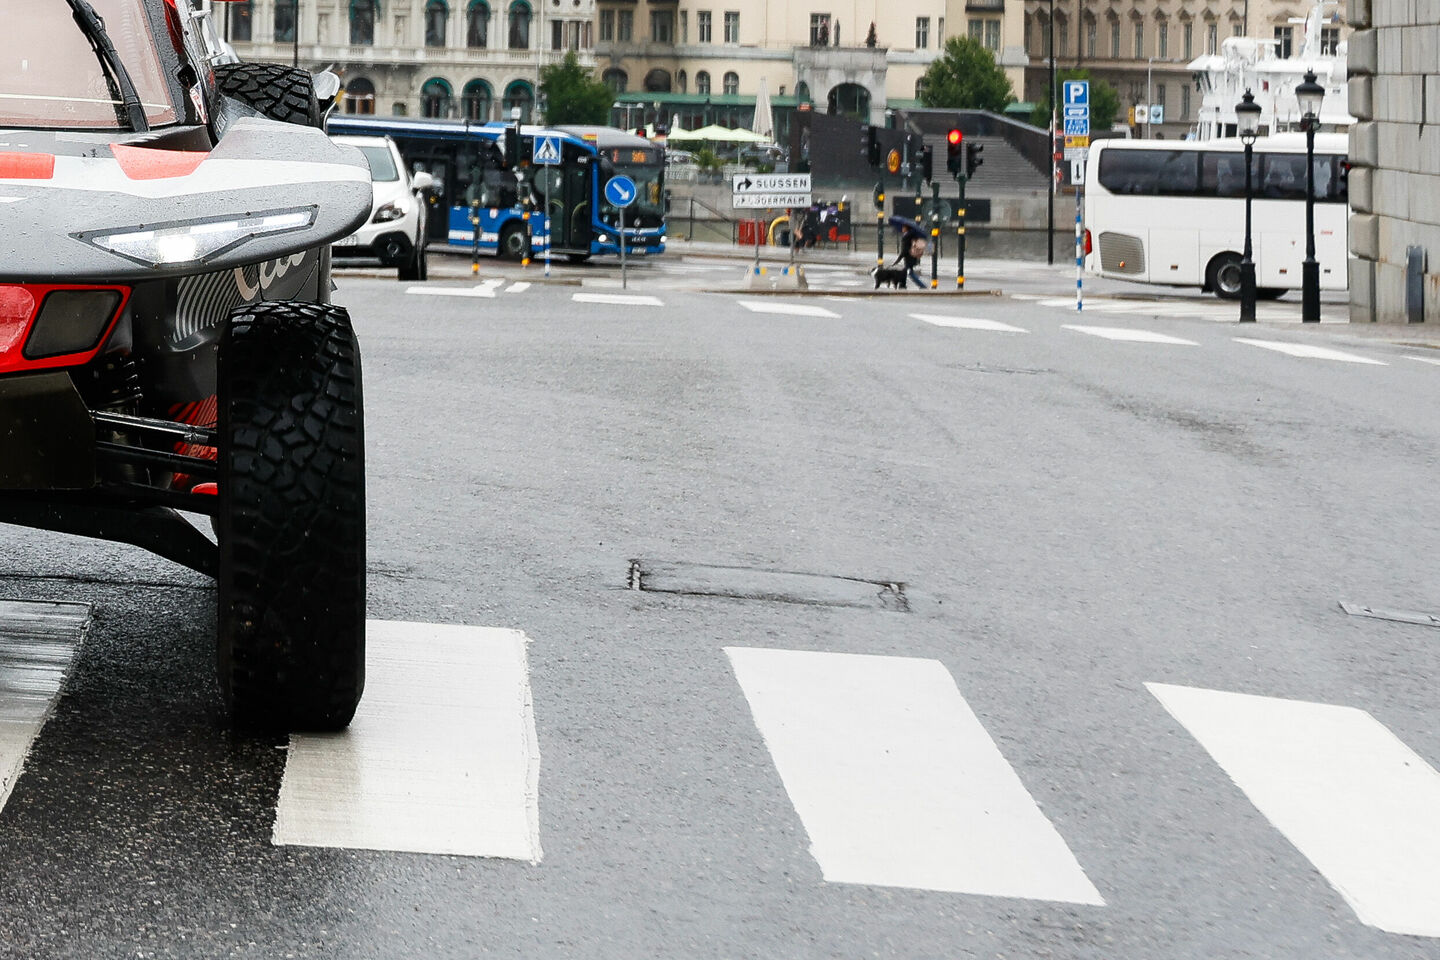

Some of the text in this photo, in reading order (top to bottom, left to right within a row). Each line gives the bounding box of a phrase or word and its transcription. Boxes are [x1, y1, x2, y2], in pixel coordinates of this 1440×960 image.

[1069, 84, 1084, 104] P
[755, 179, 807, 189] SLUSSEN
[748, 195, 805, 205] DERMALM
